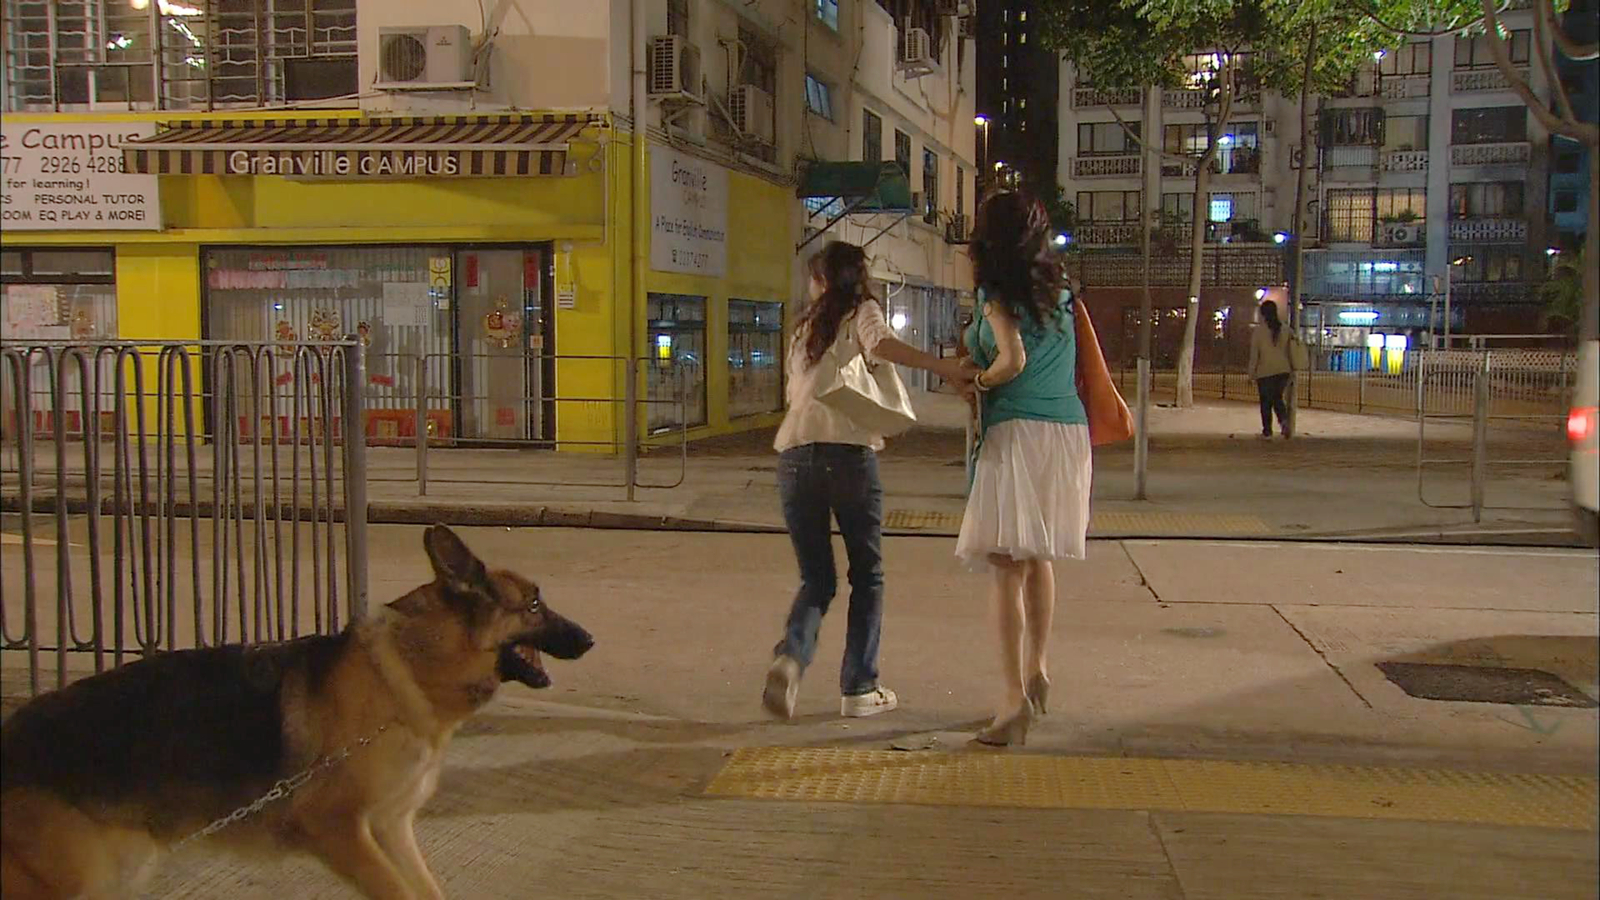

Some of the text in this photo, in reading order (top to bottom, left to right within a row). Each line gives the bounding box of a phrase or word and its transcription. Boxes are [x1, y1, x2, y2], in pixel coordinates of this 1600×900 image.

[21, 128, 140, 155] Campus
[41, 156, 81, 174] 2926
[87, 156, 126, 174] 4288
[229, 150, 457, 175] Granville CAMPUS
[7, 178, 90, 191] for learning!
[672, 160, 707, 191] Granville
[34, 194, 98, 205] PERSONAL
[103, 194, 145, 205] TUTOR
[39, 210, 57, 222] EQ
[61, 210, 91, 221] PLAY
[95, 211, 103, 221] &
[108, 210, 146, 221] MORE!
